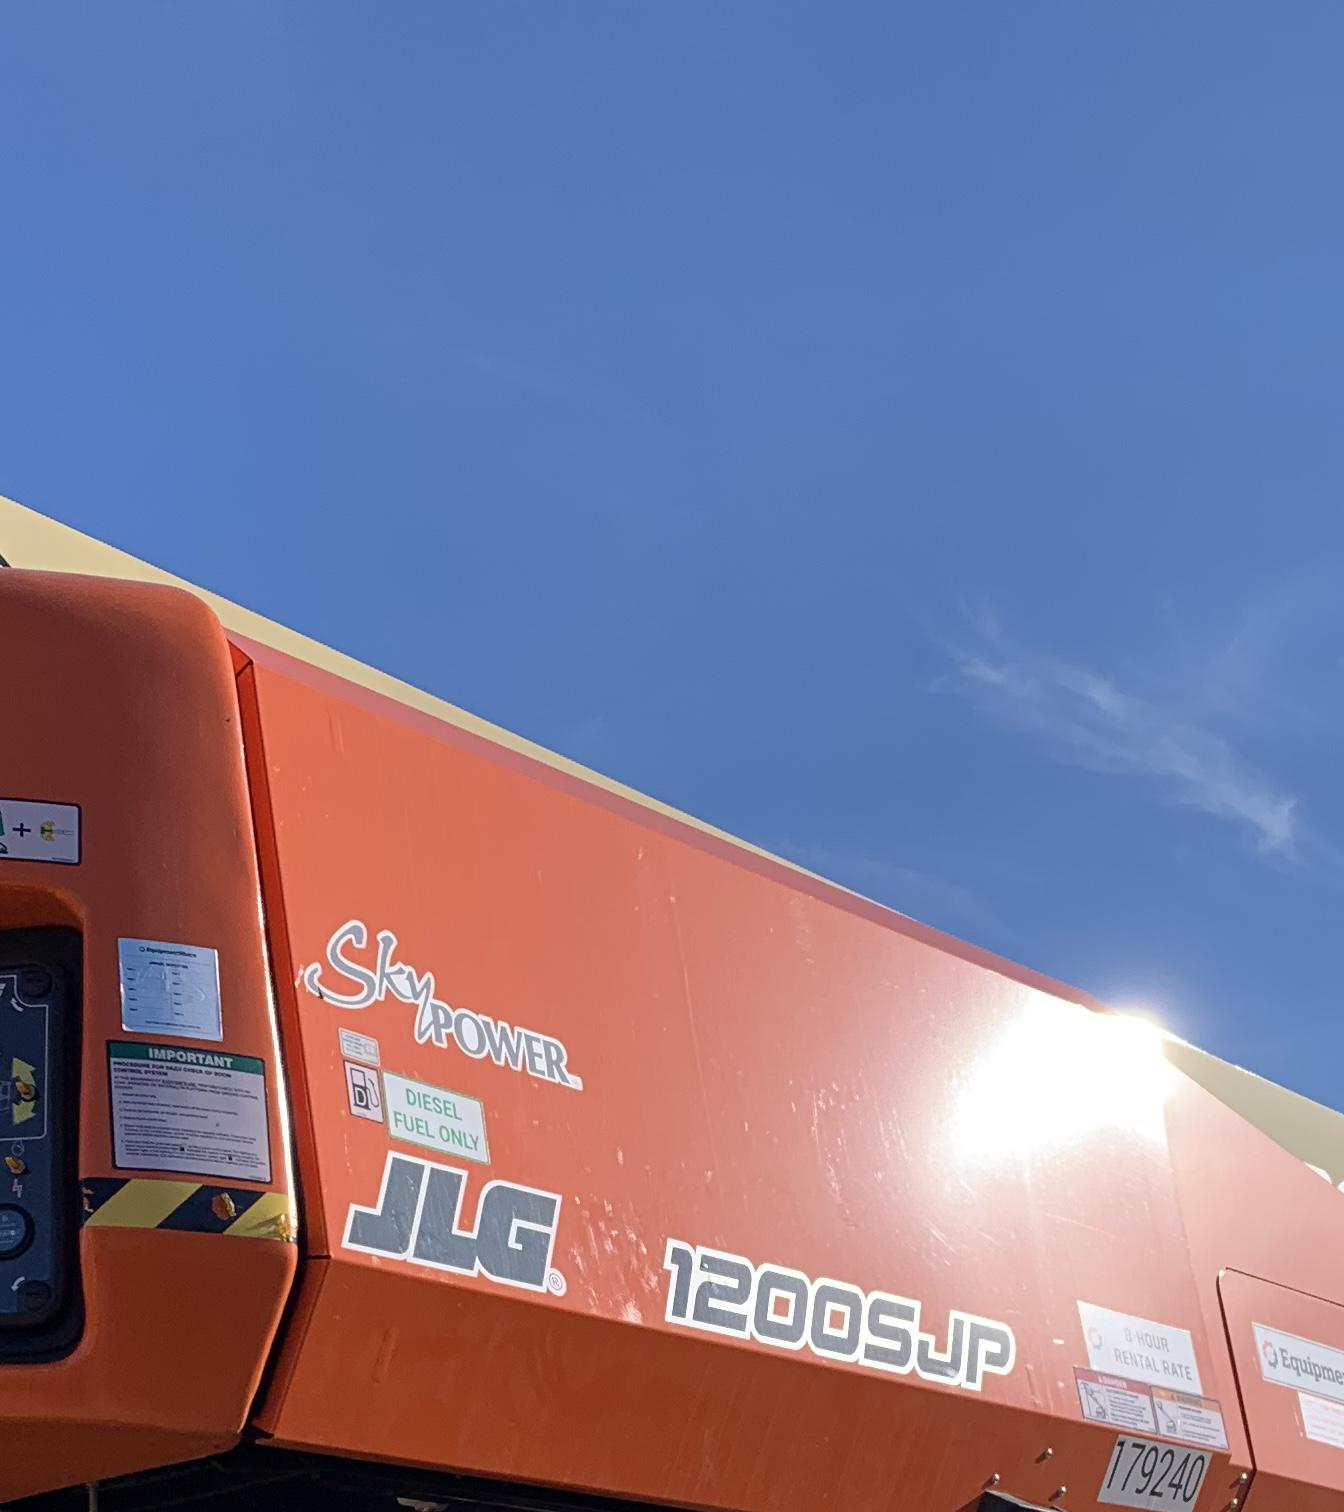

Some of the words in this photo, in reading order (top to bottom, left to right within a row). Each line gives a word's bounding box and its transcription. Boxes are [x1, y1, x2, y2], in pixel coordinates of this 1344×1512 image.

[305, 921, 435, 1043] Sky
[430, 1003, 578, 1088] POWER
[147, 1047, 234, 1069] IMPORTANT
[405, 1088, 463, 1121] DIESEL
[393, 1112, 436, 1139] FUEL
[440, 1126, 480, 1152] ONLY
[343, 1151, 561, 1293] JLG
[664, 1239, 1015, 1391] 1200SJP
[1123, 1326, 1170, 1353] 8-HOUR
[1113, 1347, 1160, 1374] RENTAL
[1162, 1359, 1193, 1381] RATE
[1106, 1438, 1205, 1503] 179240
